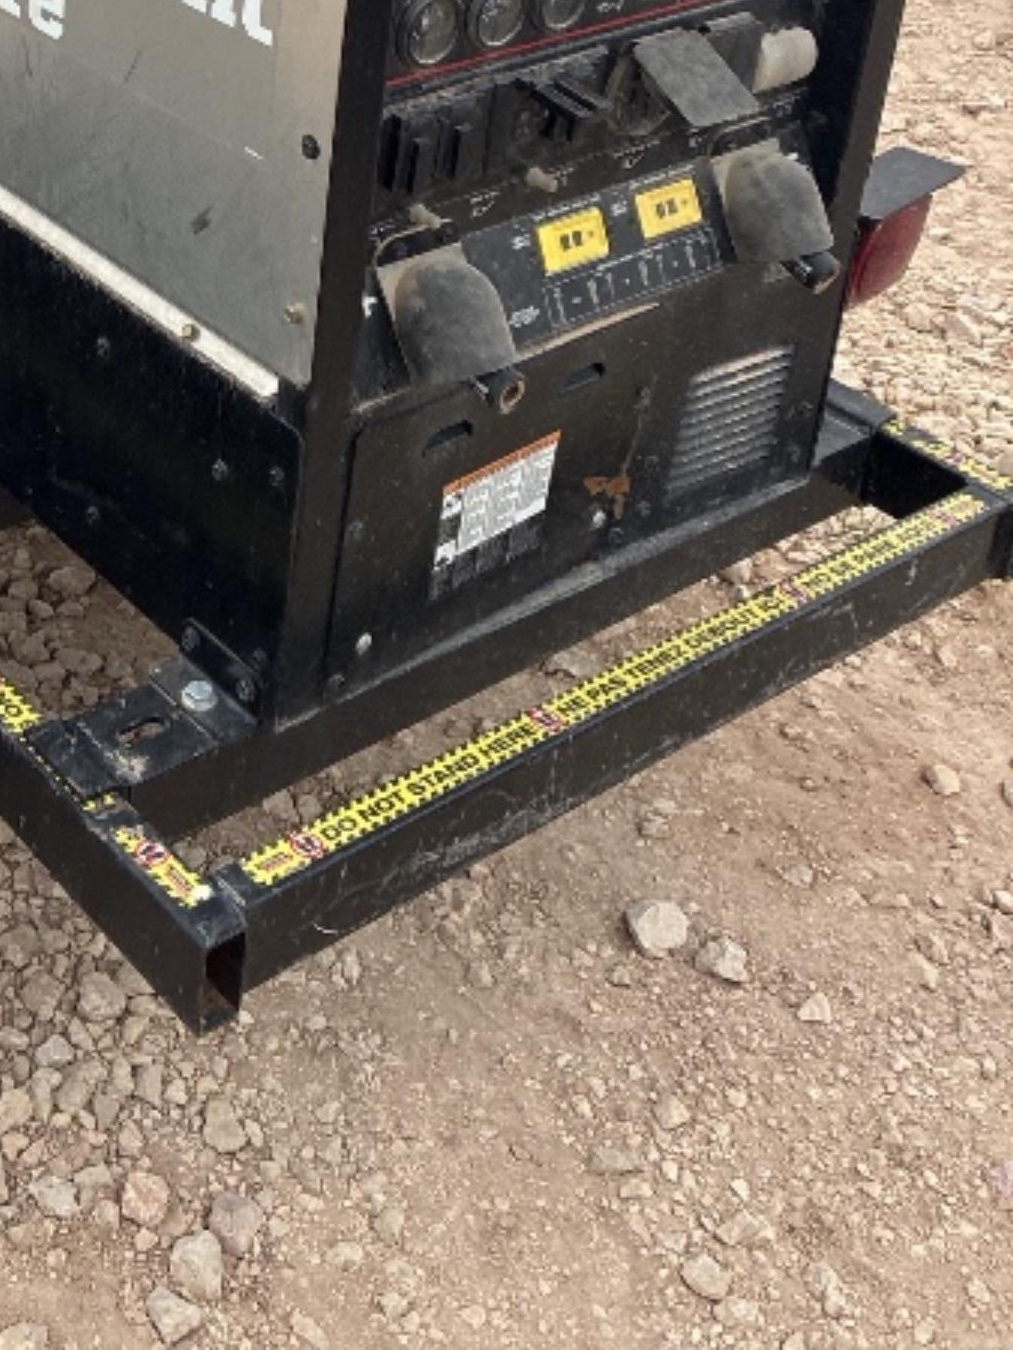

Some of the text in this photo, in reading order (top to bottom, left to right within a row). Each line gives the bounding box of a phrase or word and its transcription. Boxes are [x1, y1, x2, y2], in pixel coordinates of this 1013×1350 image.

[319, 722, 538, 843] DO NOT STAND HERE
